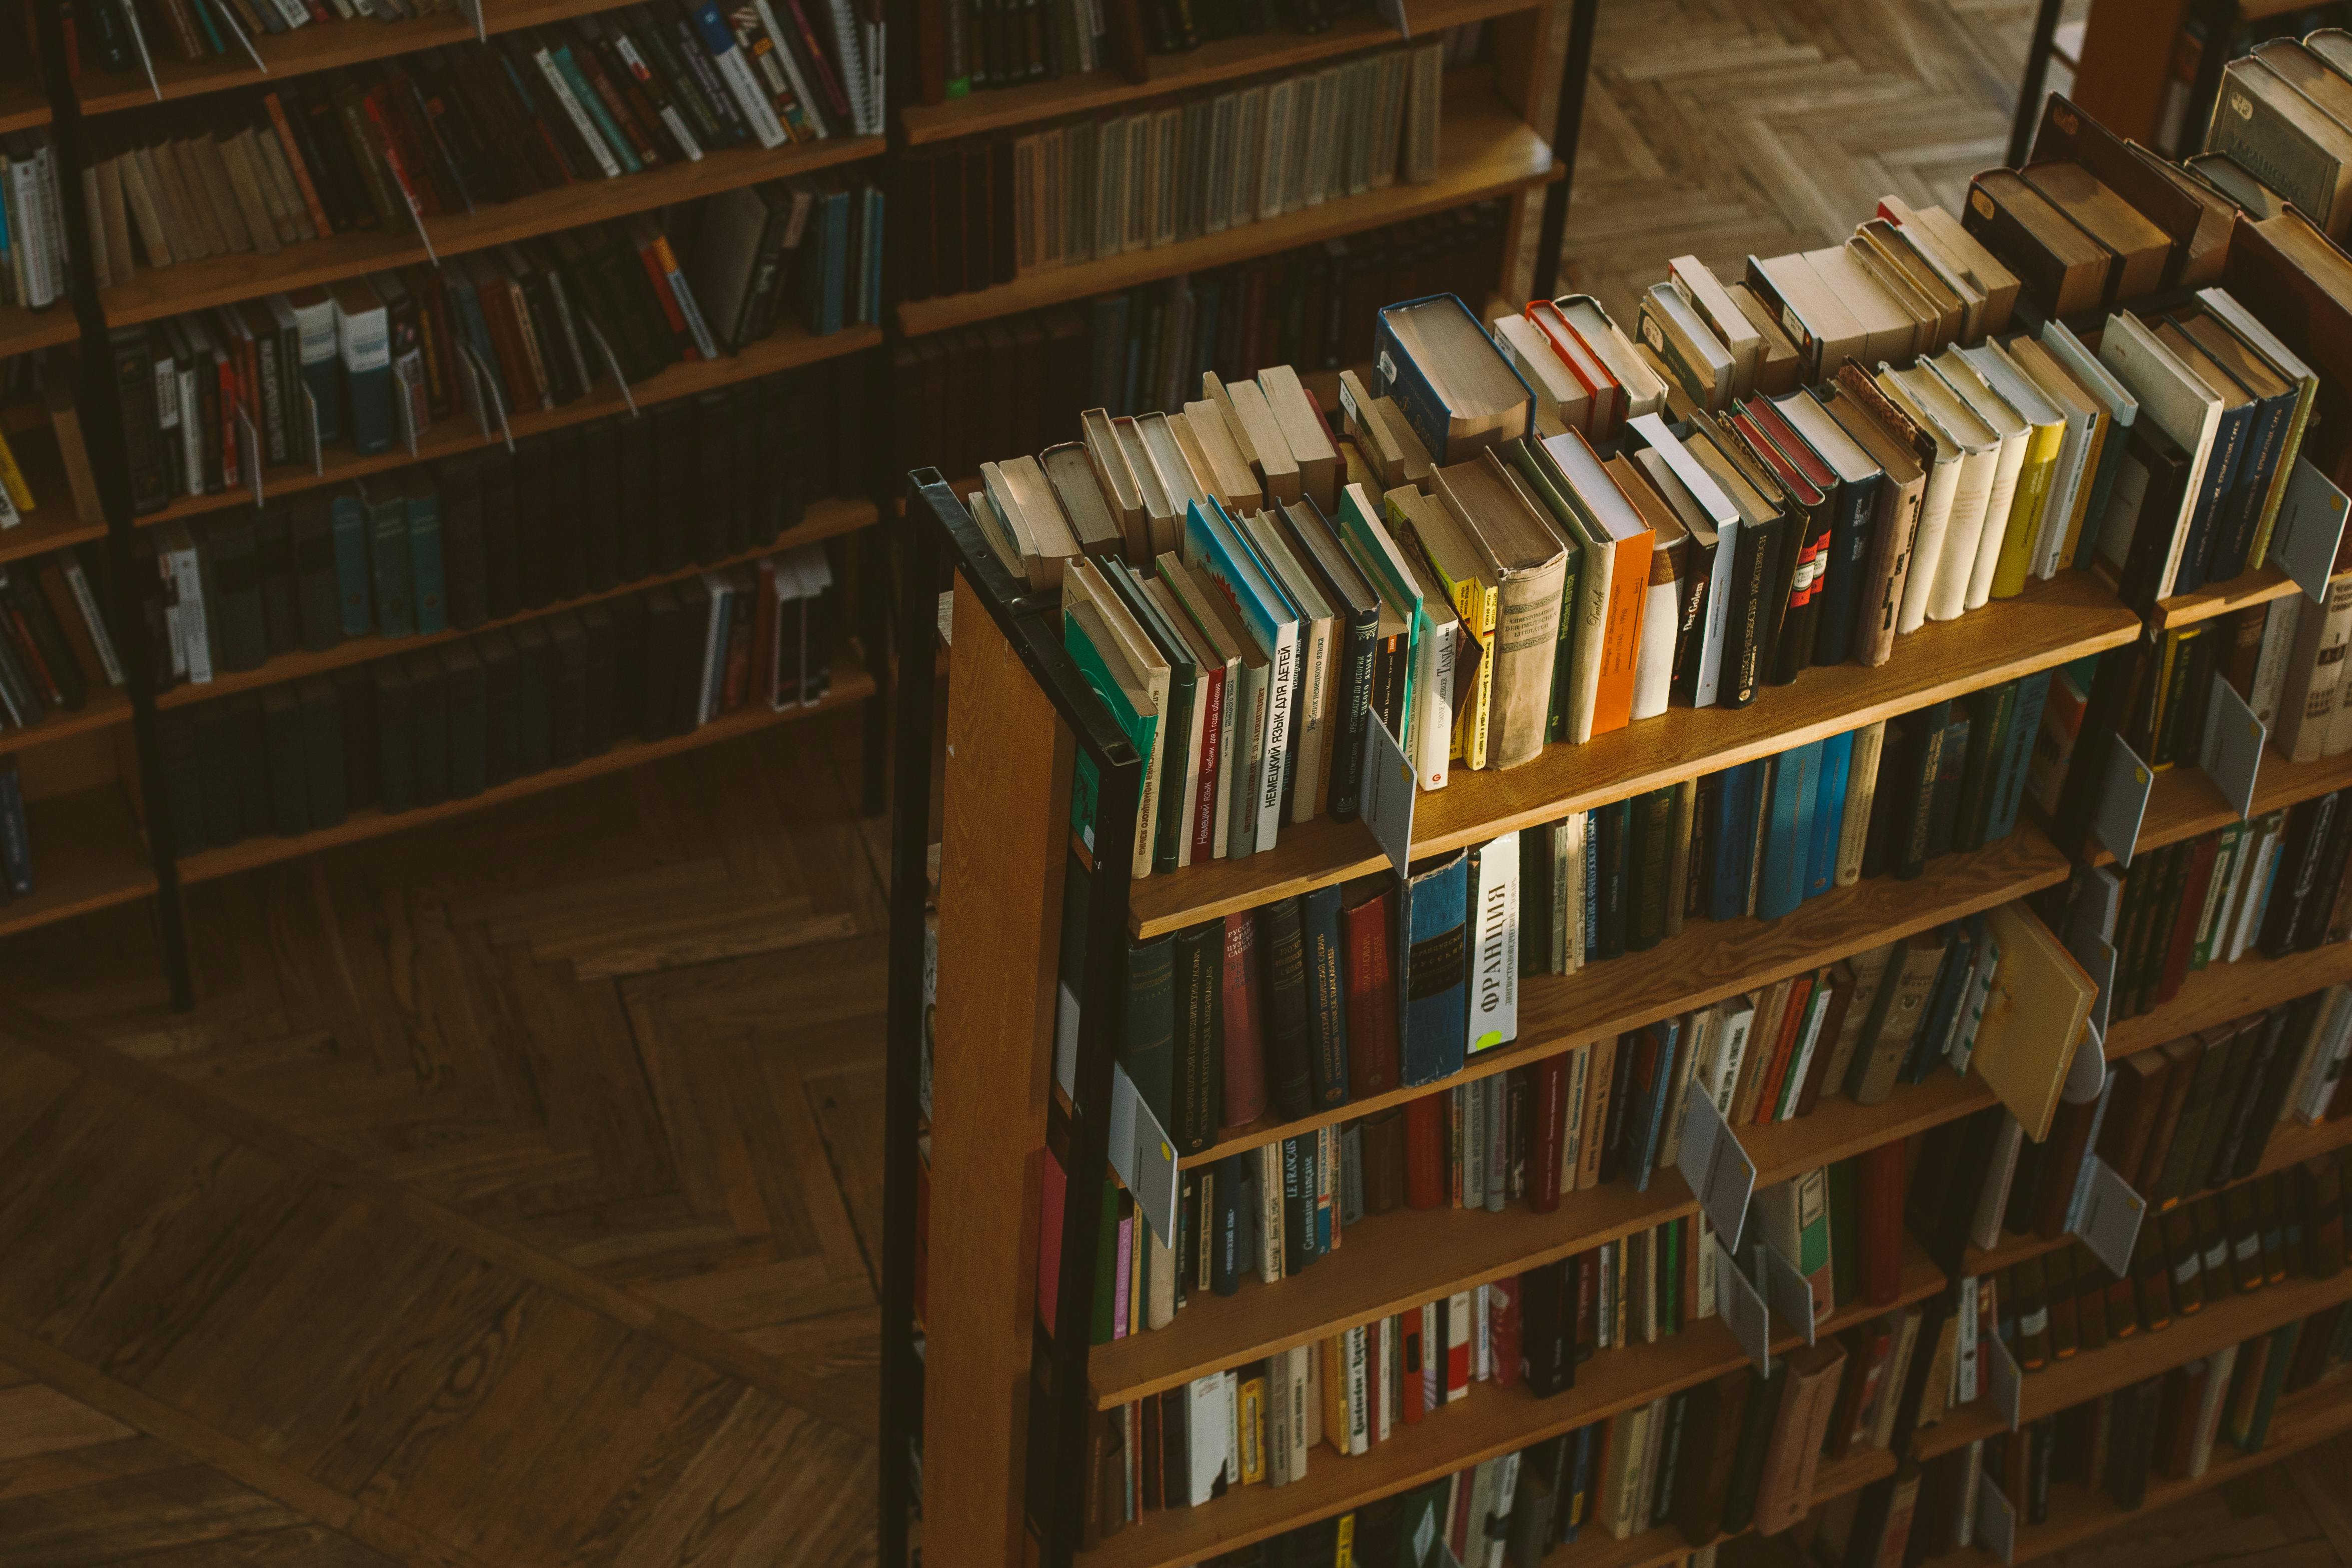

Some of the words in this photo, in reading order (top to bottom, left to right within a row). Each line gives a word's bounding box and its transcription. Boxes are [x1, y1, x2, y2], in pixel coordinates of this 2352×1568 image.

[1505, 624, 1520, 633] DER
[1521, 612, 1558, 629] DEUTSCHEN
[1683, 615, 1695, 632] Der
[1689, 582, 1704, 614] Golem
[1514, 623, 1549, 638] LITERATUR
[1279, 645, 1291, 682] ДЕТЕЙ
[1312, 660, 1323, 700] немецкого
[1355, 655, 1364, 685] ИСТОРИИ
[1437, 643, 1453, 679] TANJA
[1276, 685, 1288, 708] ДЛЯ
[1353, 684, 1361, 695] ПО
[1358, 684, 1370, 732] НЕМЕЦКОГО
[1364, 651, 1373, 680] ЯЗЫКА
[1205, 746, 1215, 774] Учебник
[1211, 682, 1221, 712] обучения
[1254, 687, 1265, 742] JAHRHUNDERT
[1273, 711, 1285, 743] ЯЗЫК
[1307, 700, 1318, 731] Учебник
[1349, 694, 1360, 734] ХРЕСТОМАТИЯ
[1552, 715, 1559, 725] 2
[1266, 745, 1281, 808] НЕМЕЦКИЙ
[1140, 781, 1153, 828] немецкого
[1197, 803, 1209, 844] Немецкий
[1204, 781, 1212, 801] язык
[1138, 829, 1148, 855] языка
[1588, 816, 1596, 842] ЯЗЫКА
[1509, 876, 1518, 911] СЛОВАРЬ
[1191, 948, 1200, 981] СЛОВАРЬ
[1481, 881, 1506, 1013] ФРАНЦИЯ
[1505, 912, 1516, 1006] ЛИНГВОСТРАНОВЕДЧЕСКИЙ
[1319, 963, 1327, 1008] ТЕХНИЧЕСКИЙ
[1188, 983, 1199, 1054] ПОЛИТЕХНИЧЕСКИЙ
[1202, 1026, 1210, 1083] POLYTECHNIQUE
[1200, 1085, 1208, 1134] DICTIONNAIRE
[1286, 1139, 1298, 1183] FRANÇAIS
[1303, 1155, 1314, 1198] française
[1287, 1184, 1298, 1198] LE
[1302, 1198, 1314, 1250] Grammaire
